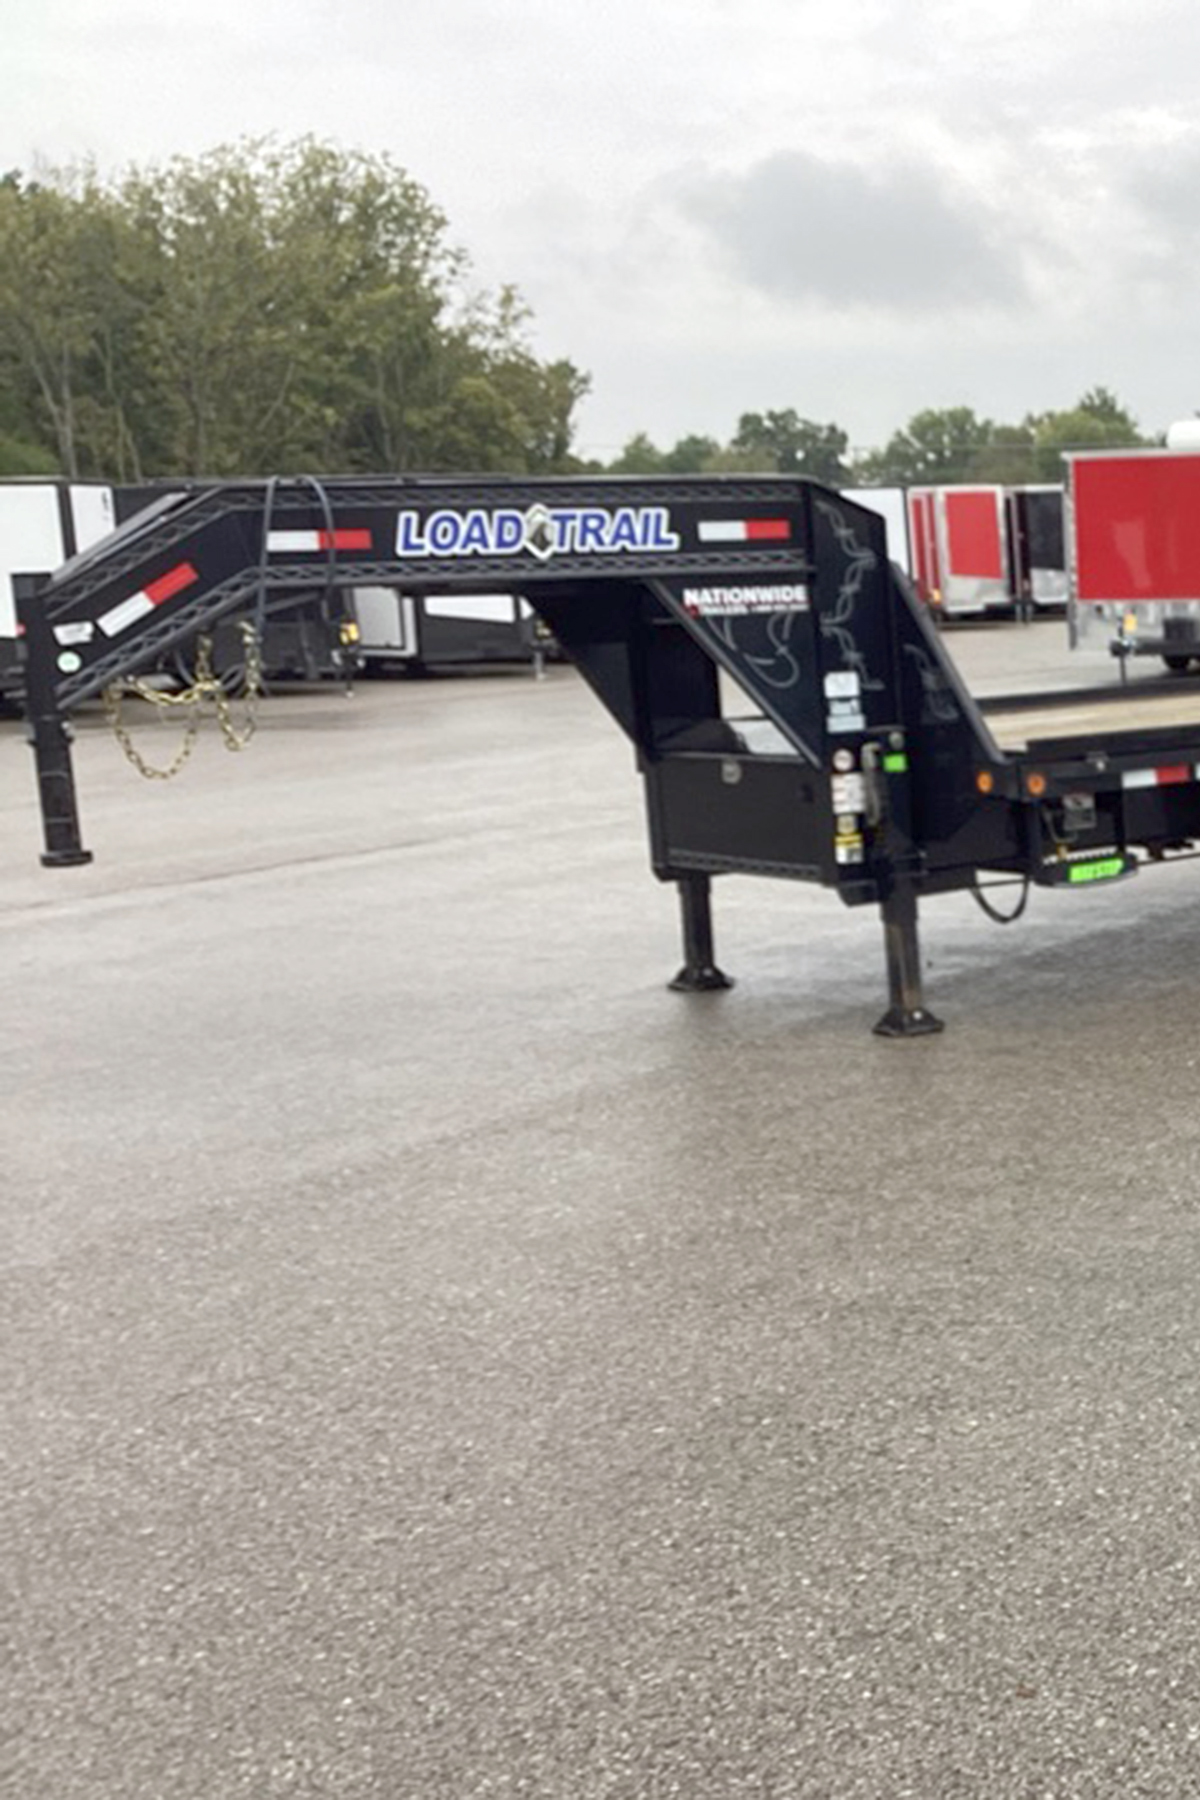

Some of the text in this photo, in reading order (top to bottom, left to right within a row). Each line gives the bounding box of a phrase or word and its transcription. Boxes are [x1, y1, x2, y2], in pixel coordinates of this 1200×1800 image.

[398, 508, 679, 556] LOAD TRAIL
[683, 585, 807, 607] NATIONWIDE
